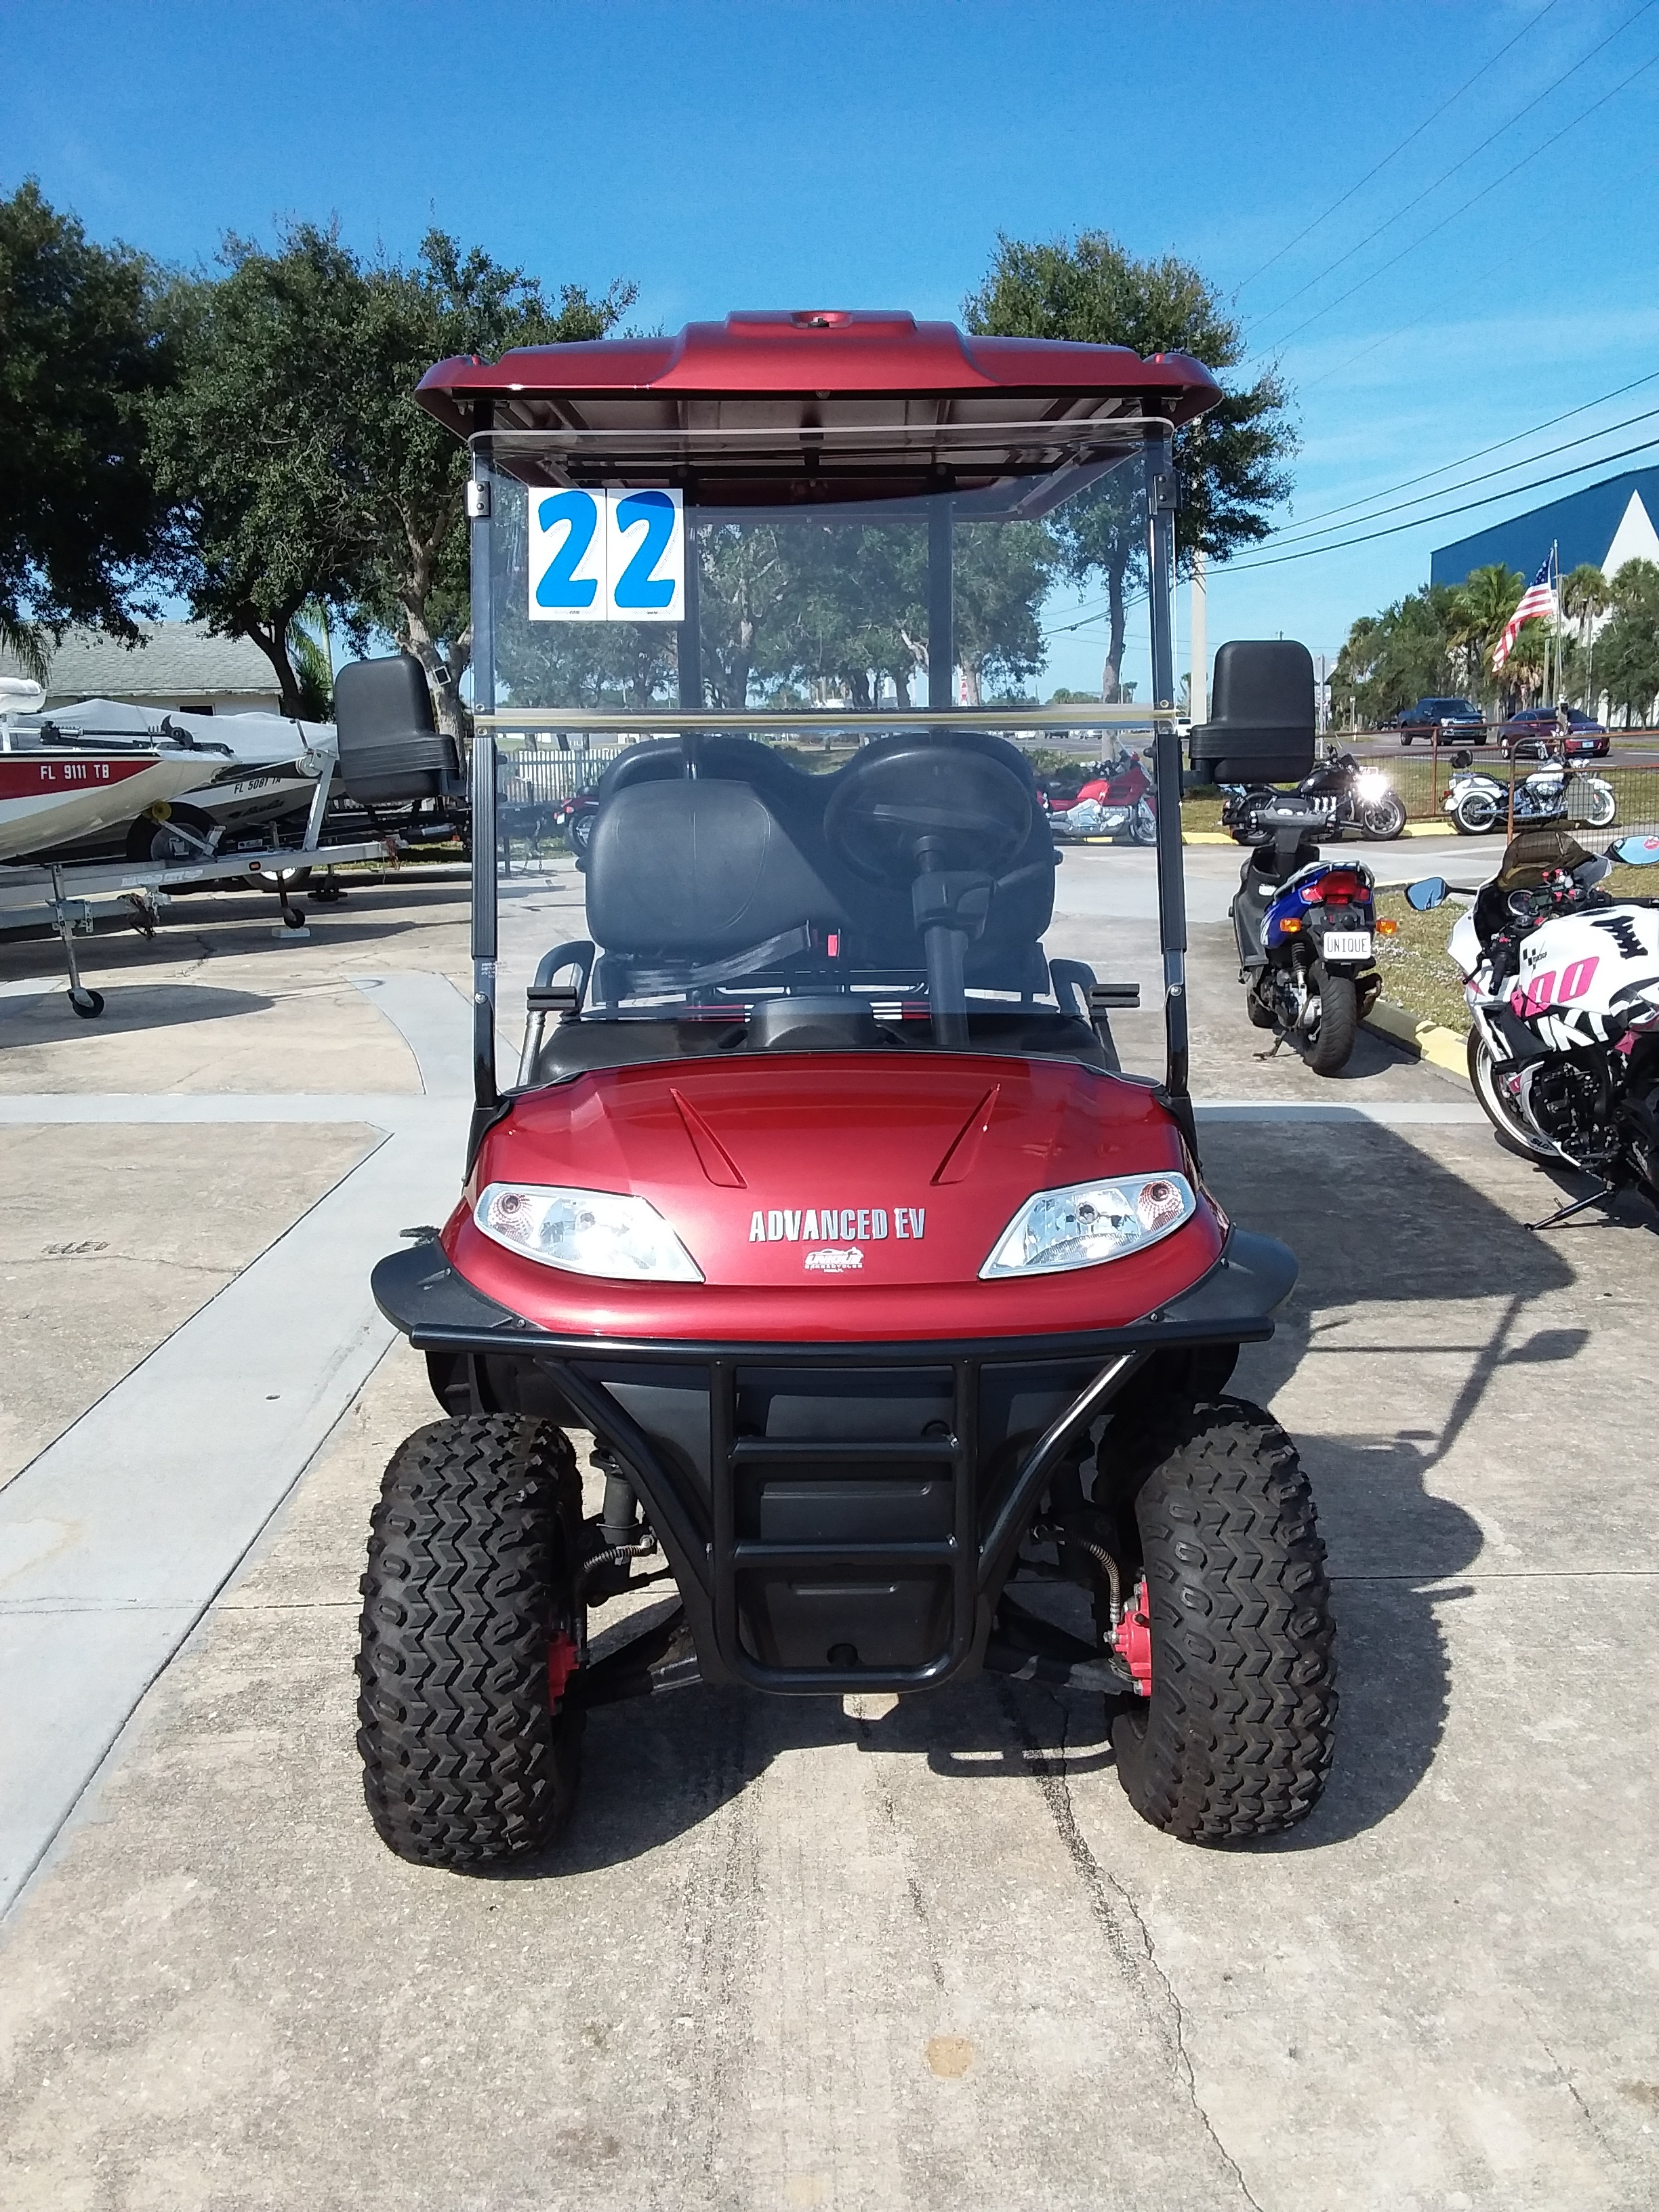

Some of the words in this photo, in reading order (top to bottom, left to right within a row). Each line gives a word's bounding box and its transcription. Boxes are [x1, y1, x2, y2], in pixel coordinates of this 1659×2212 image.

[536, 490, 676, 608] 22
[40, 765, 56, 780] FL
[64, 764, 87, 779] 9111
[233, 783, 244, 794] FL
[1327, 938, 1368, 953] UNIQUE
[748, 1208, 888, 1242] ADVANCED
[894, 1207, 926, 1239] EV
